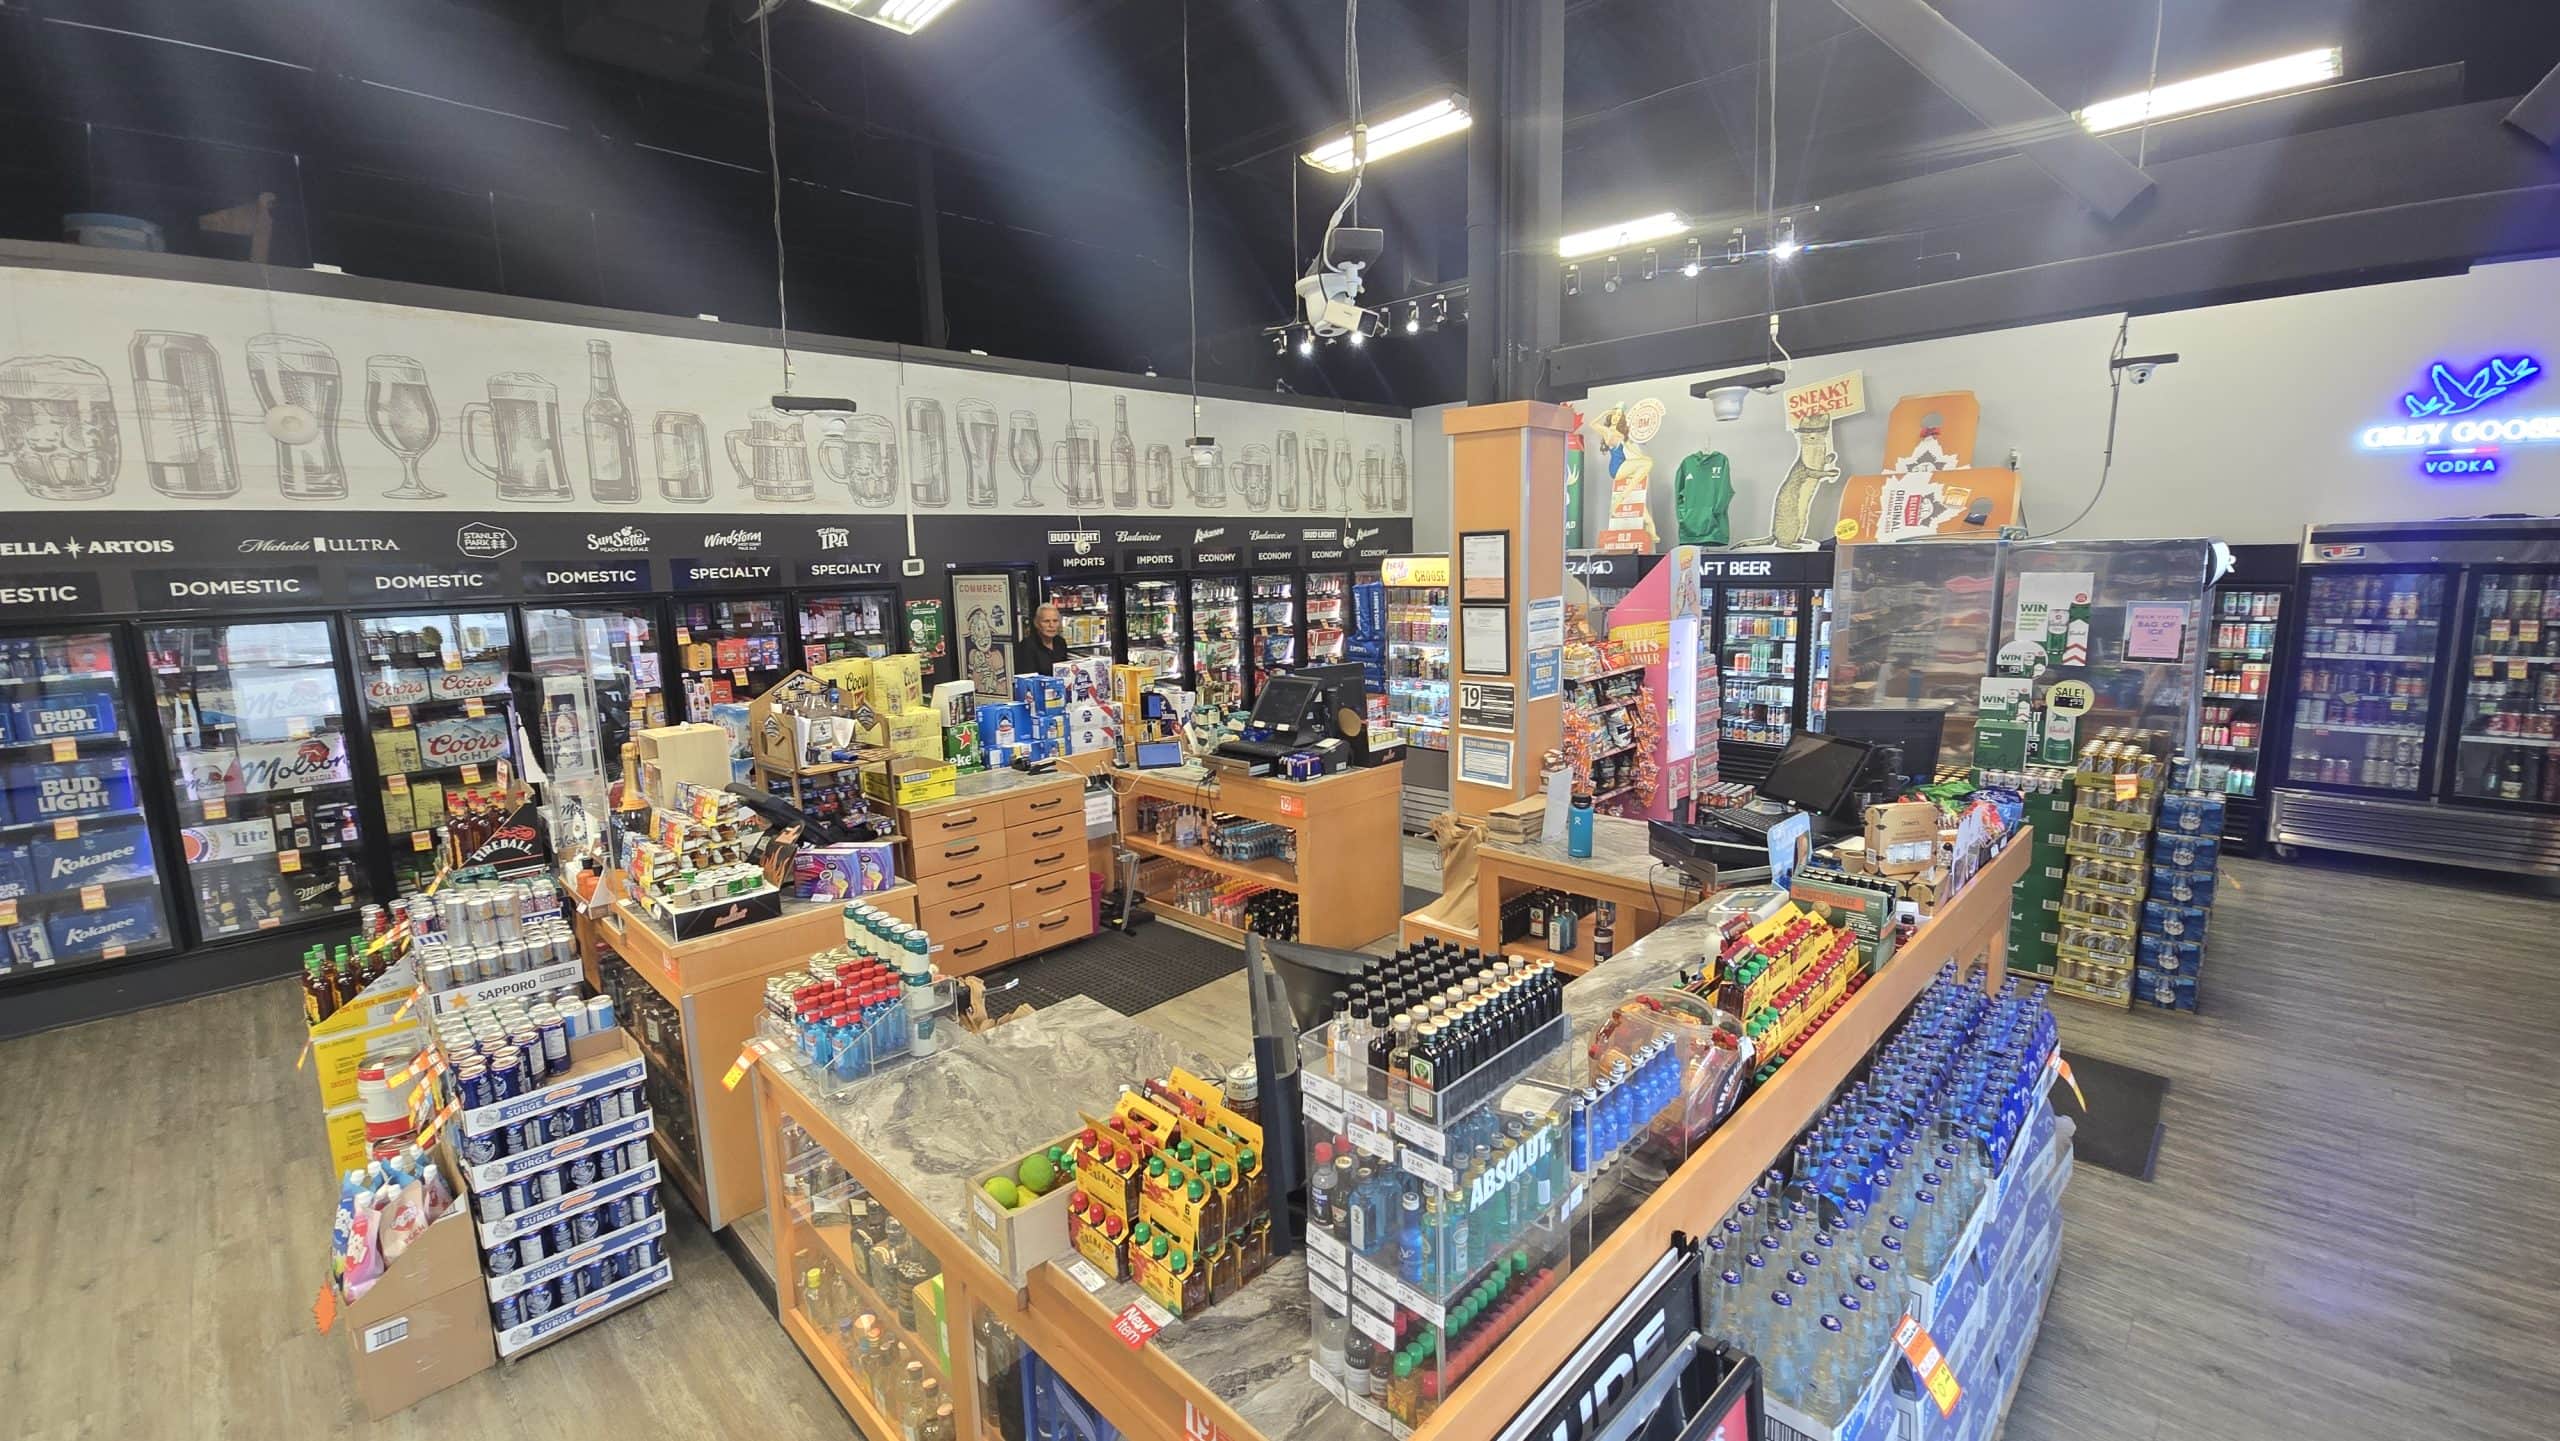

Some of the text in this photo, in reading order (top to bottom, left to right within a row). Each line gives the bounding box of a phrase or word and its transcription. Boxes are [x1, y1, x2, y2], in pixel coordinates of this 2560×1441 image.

[1790, 380, 1850, 408] SNEAKY
[1791, 396, 1852, 420] WEASEL
[2425, 459, 2496, 473] VODKA
[1891, 490, 1905, 533] ORIGINAL
[464, 532, 506, 540] STANLEY
[587, 531, 651, 550] SunSetter
[704, 530, 761, 548] Windstorm
[822, 533, 848, 550] IPA
[1050, 532, 1099, 542] BUD LIGHT
[1115, 531, 1162, 543] Budweiser
[88, 539, 174, 553] ARTOIS
[237, 538, 400, 553] Michelob ULTRA
[1063, 557, 1105, 567] IMPORTS
[1136, 555, 1174, 564] IMPORTS
[1198, 553, 1236, 563] ECONOMY
[1258, 552, 1291, 561] ECONOMY
[1311, 550, 1343, 559] ECONOMY
[546, 570, 636, 584] DOMESTIC
[689, 566, 771, 580] SPECIALTY
[811, 563, 882, 576] SPECIALTY
[1729, 561, 1771, 576] BEER
[170, 579, 300, 596] DOMESTIC
[375, 573, 483, 590] DOMESTIC
[959, 583, 1003, 593] COMMERCE
[2020, 603, 2048, 613] WIN
[2001, 654, 2022, 662] WIN
[369, 680, 424, 696] Coors
[441, 673, 494, 691] Coors
[452, 686, 487, 697] LIGHT
[1462, 687, 1479, 707] 19
[1982, 695, 2005, 704] WIN
[2056, 687, 2085, 698] SALE!
[40, 708, 87, 723] BUD
[34, 718, 97, 735] LIGHT
[429, 732, 502, 754] Coors
[444, 750, 490, 764] LIGHT
[242, 752, 346, 789] Molson
[41, 776, 100, 797] BUD
[38, 789, 109, 813] LIGHT
[232, 830, 269, 847] Lite
[472, 839, 532, 862] FIREBALL
[51, 845, 135, 879] Kokanee
[65, 916, 135, 946] Kokanee
[477, 979, 536, 1002] SAPPORO
[506, 1101, 543, 1118] SURGE
[512, 1155, 549, 1172] SURGE
[521, 1210, 558, 1228] SURGE
[529, 1264, 565, 1281] SURGE
[537, 1314, 573, 1334] SURGE
[1123, 1306, 1152, 1333] New
